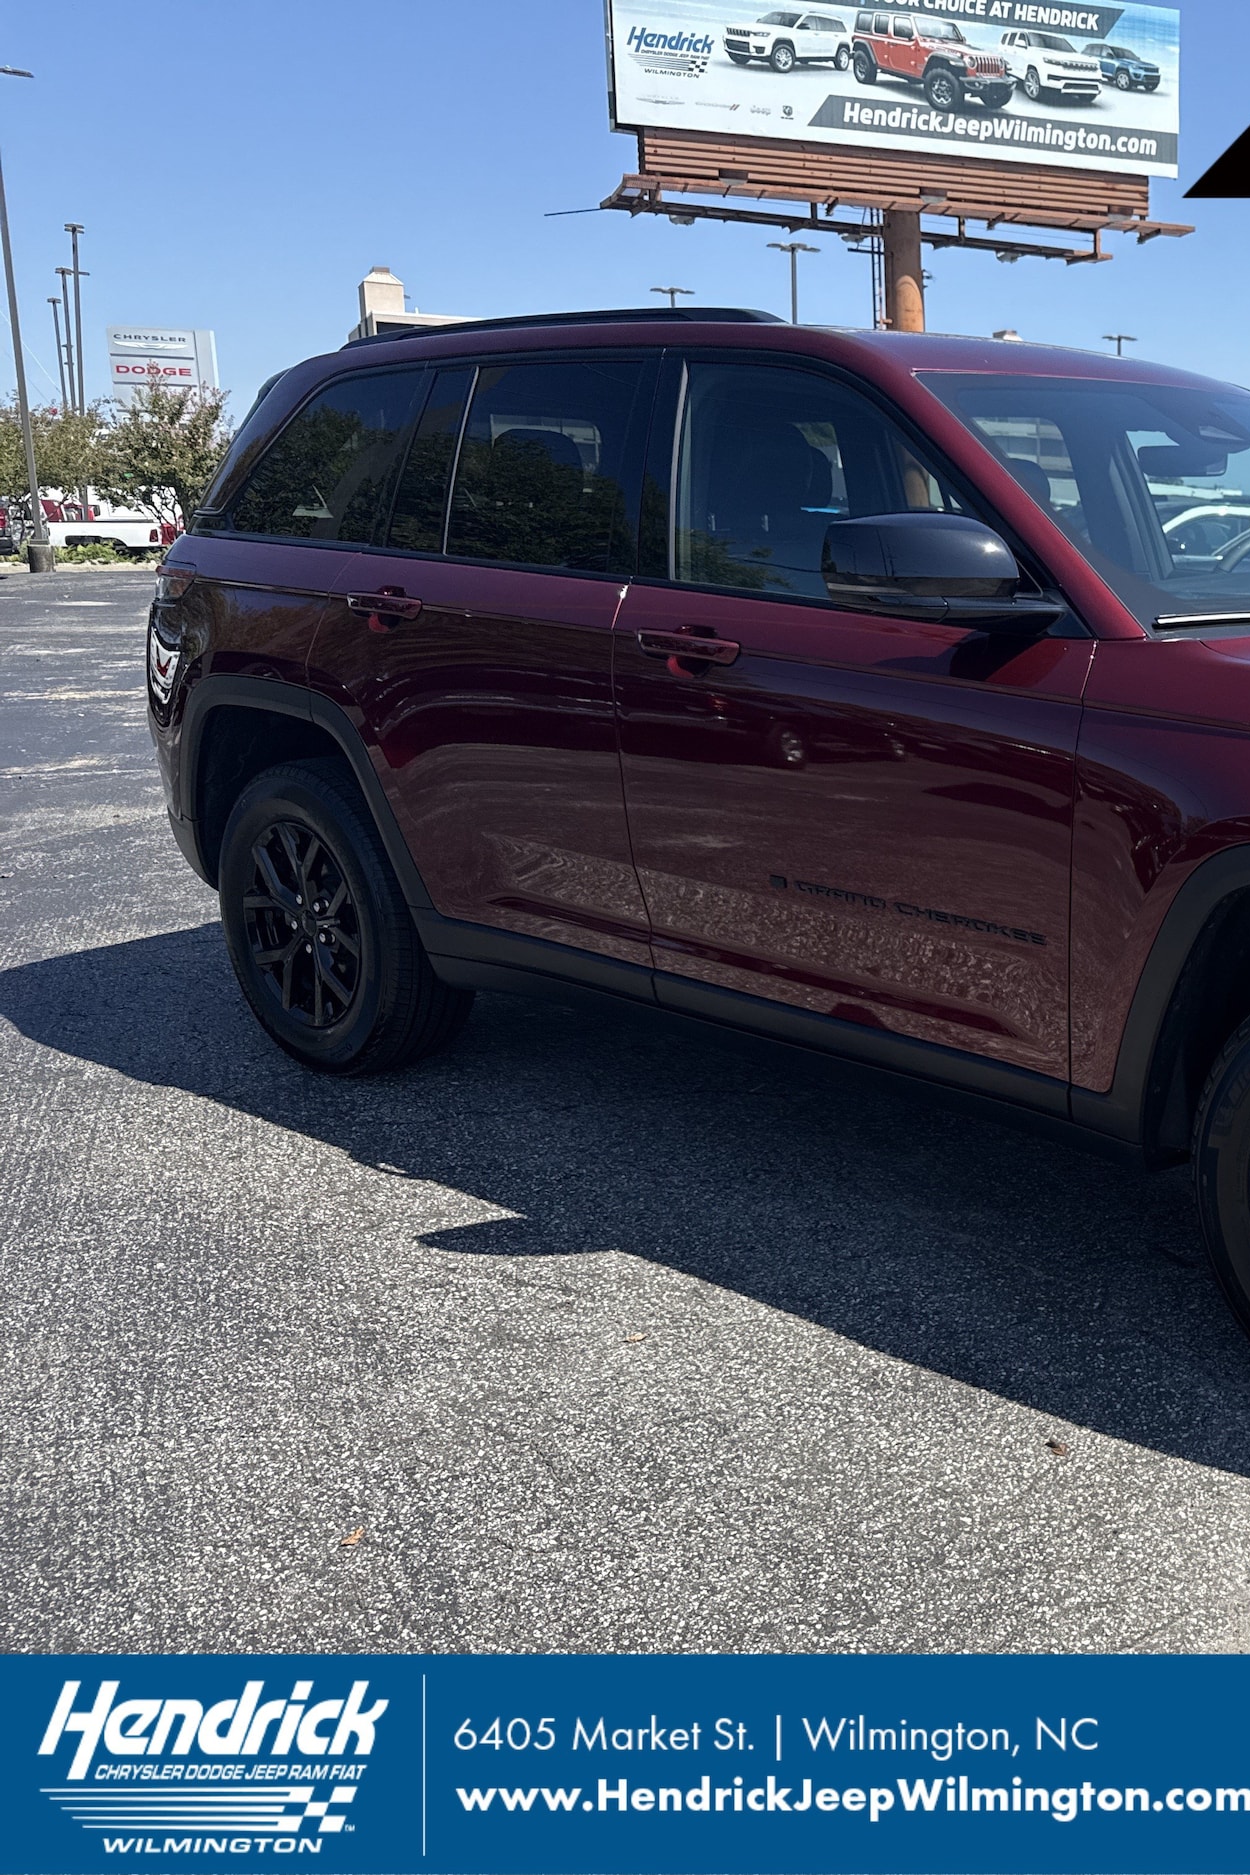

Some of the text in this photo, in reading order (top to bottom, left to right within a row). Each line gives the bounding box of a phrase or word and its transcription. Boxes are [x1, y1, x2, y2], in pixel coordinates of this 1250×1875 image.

[923, 0, 1100, 31] CHOICE AT HENDRICK
[627, 26, 714, 54] Hendrick
[644, 68, 700, 78] WILMINGTON
[842, 101, 1158, 156] HendrickJeepWilmington.com
[113, 333, 187, 343] CHRYSLER
[115, 365, 192, 376] DODGE
[794, 880, 1048, 946] GRAND CHEROKEE
